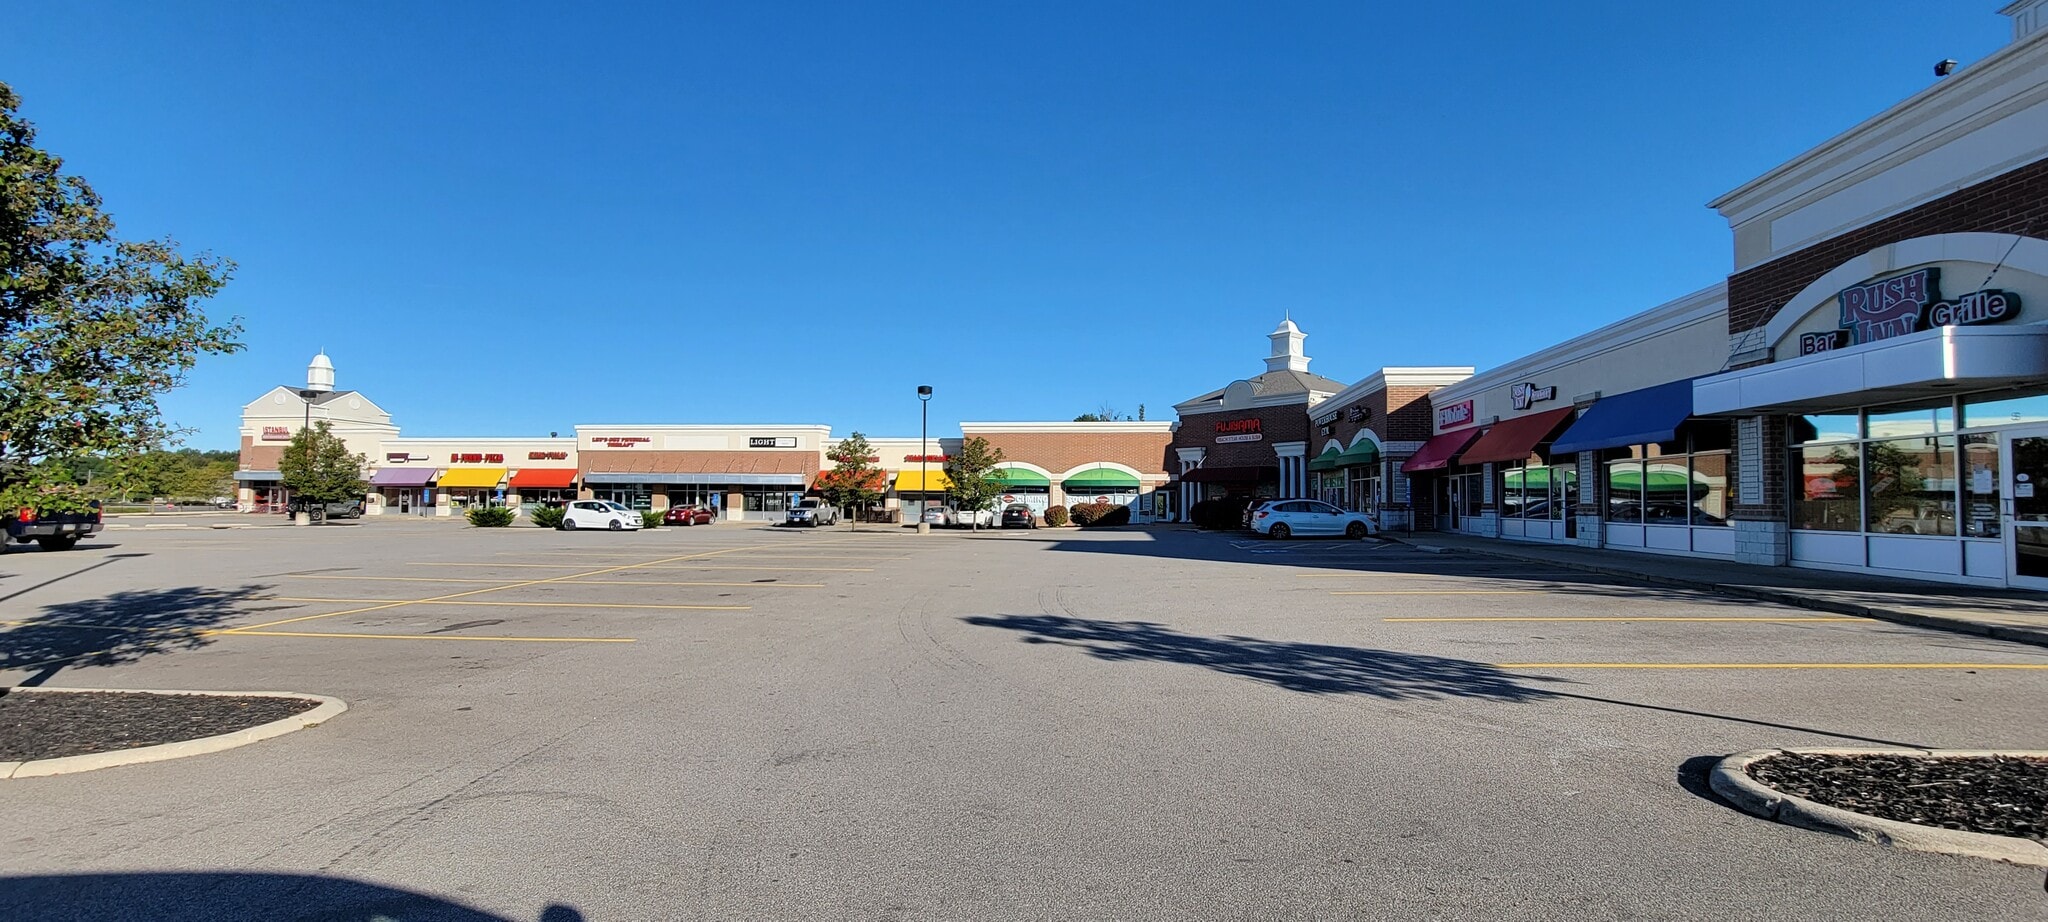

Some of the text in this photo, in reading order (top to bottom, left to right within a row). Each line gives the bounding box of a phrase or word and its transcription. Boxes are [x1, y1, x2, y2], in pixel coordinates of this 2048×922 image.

[1843, 270, 1926, 324] RUSH
[1801, 292, 2007, 355] Bar Grille
[1856, 316, 1914, 344] INN
[262, 426, 289, 434] ISTANBUL
[1215, 418, 1262, 432] FUJIYAMA
